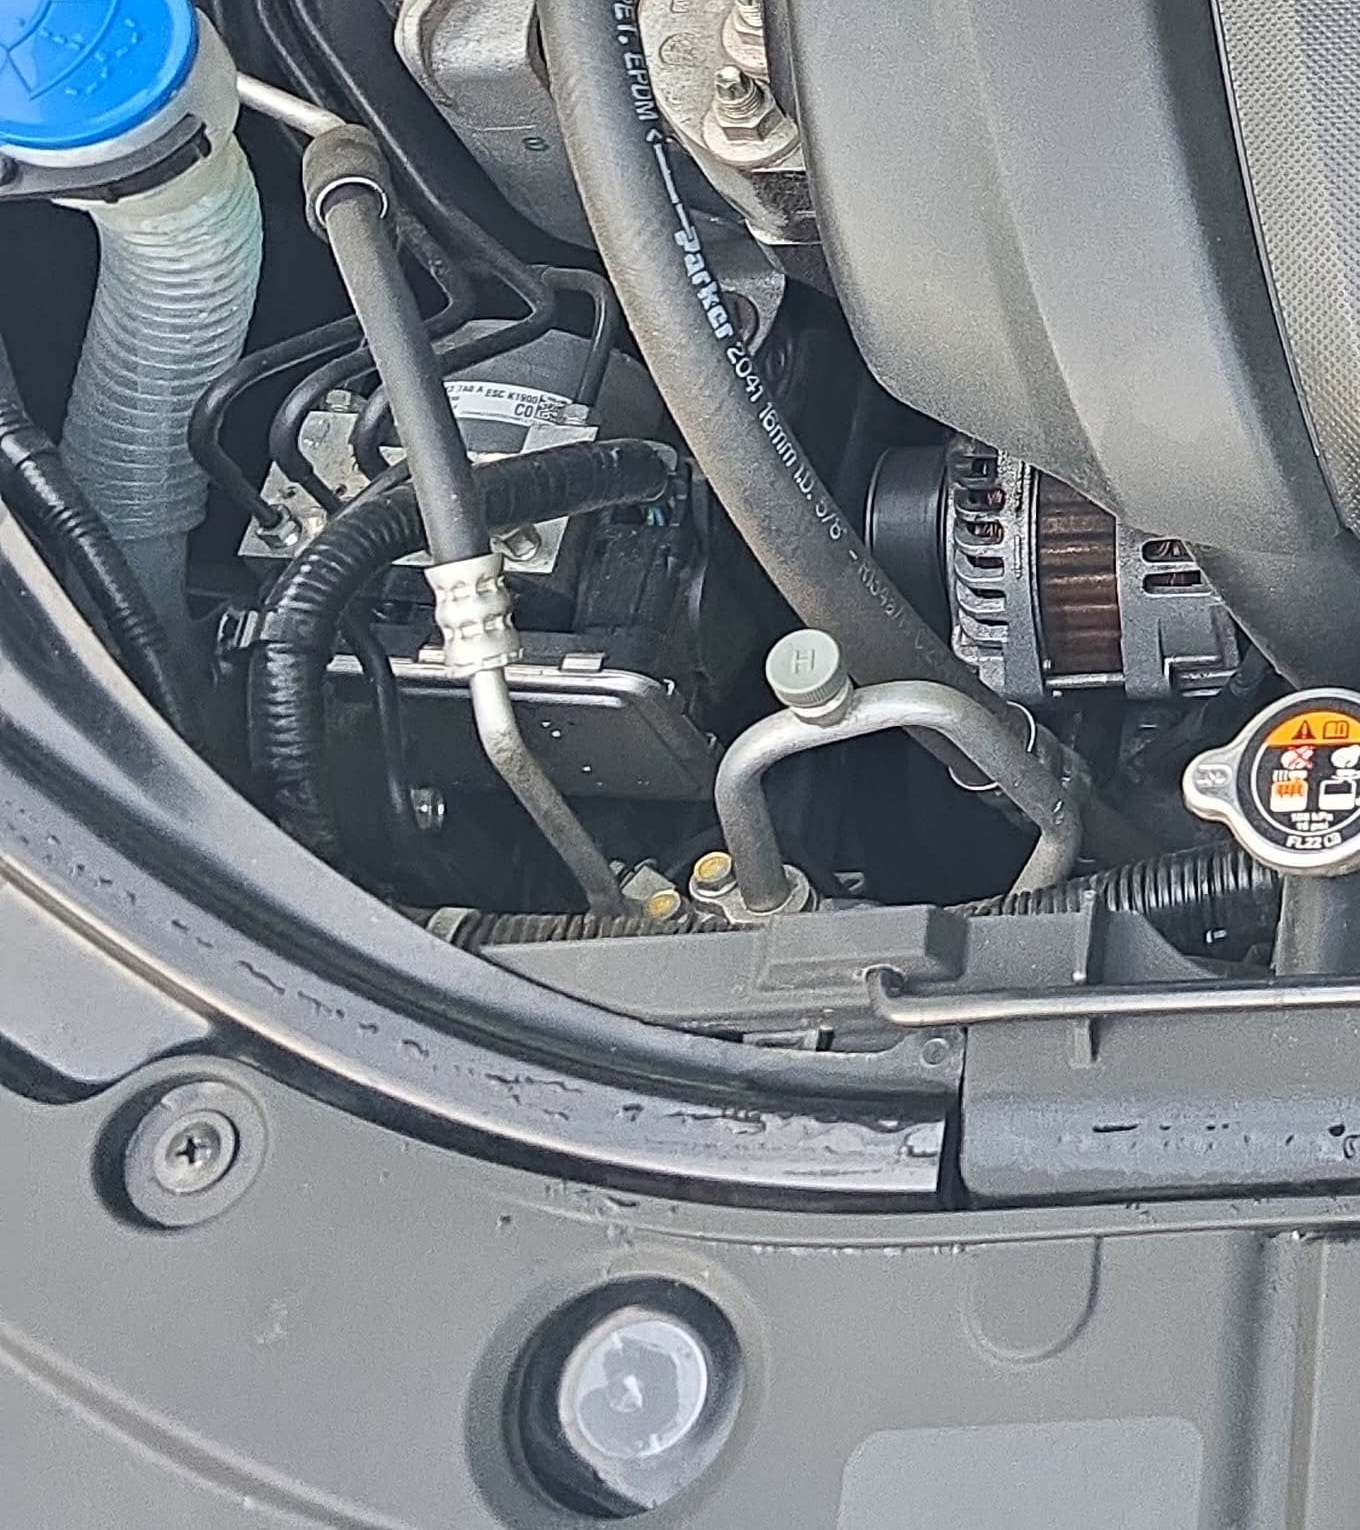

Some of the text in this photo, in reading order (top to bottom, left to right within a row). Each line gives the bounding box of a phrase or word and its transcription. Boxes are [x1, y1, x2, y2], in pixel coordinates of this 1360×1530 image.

[673, 226, 733, 339] Parker
[727, 331, 764, 402] 2041
[759, 402, 797, 467] 16mm
[485, 388, 505, 398] ESC
[792, 650, 816, 674] H
[1285, 834, 1322, 849] FL22
